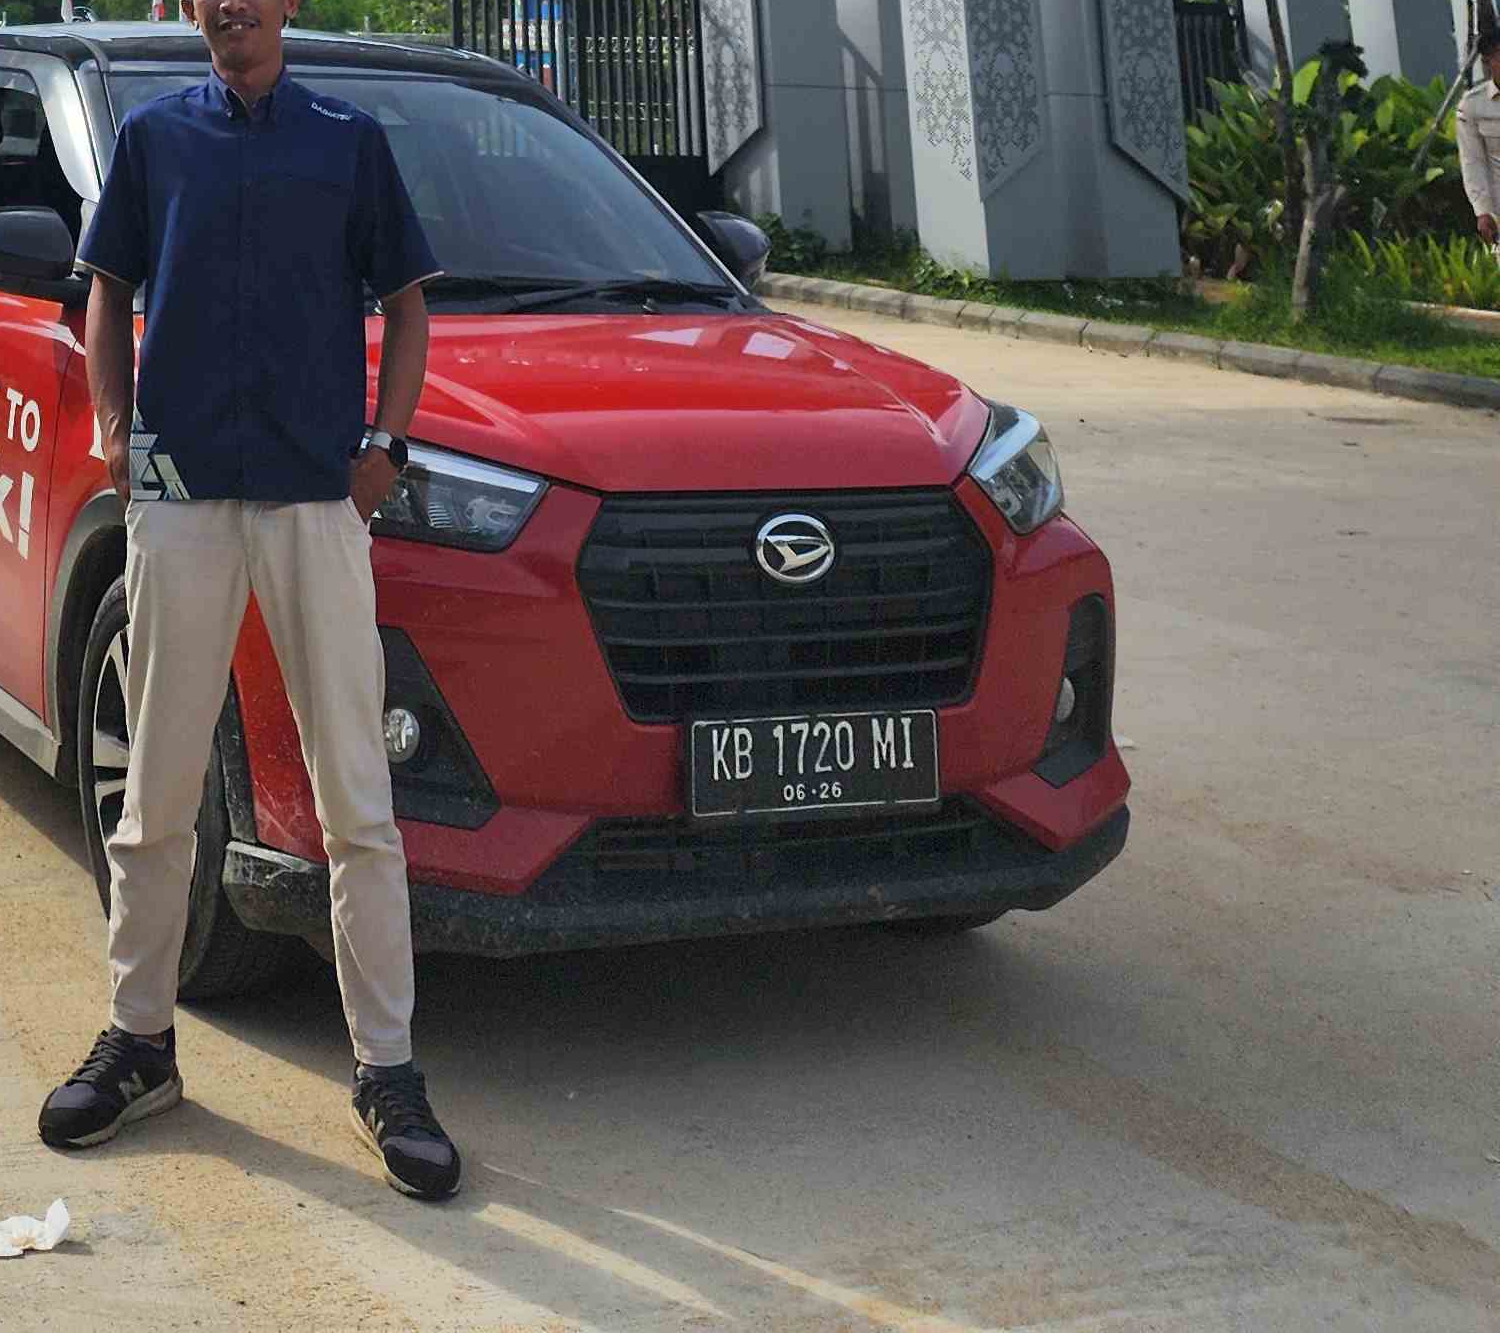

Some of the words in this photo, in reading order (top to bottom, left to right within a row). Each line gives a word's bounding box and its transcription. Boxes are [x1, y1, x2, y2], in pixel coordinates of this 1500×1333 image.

[6, 386, 40, 452] TO
[712, 727, 753, 781] KB
[773, 721, 855, 776] 1720
[871, 717, 915, 769] MI
